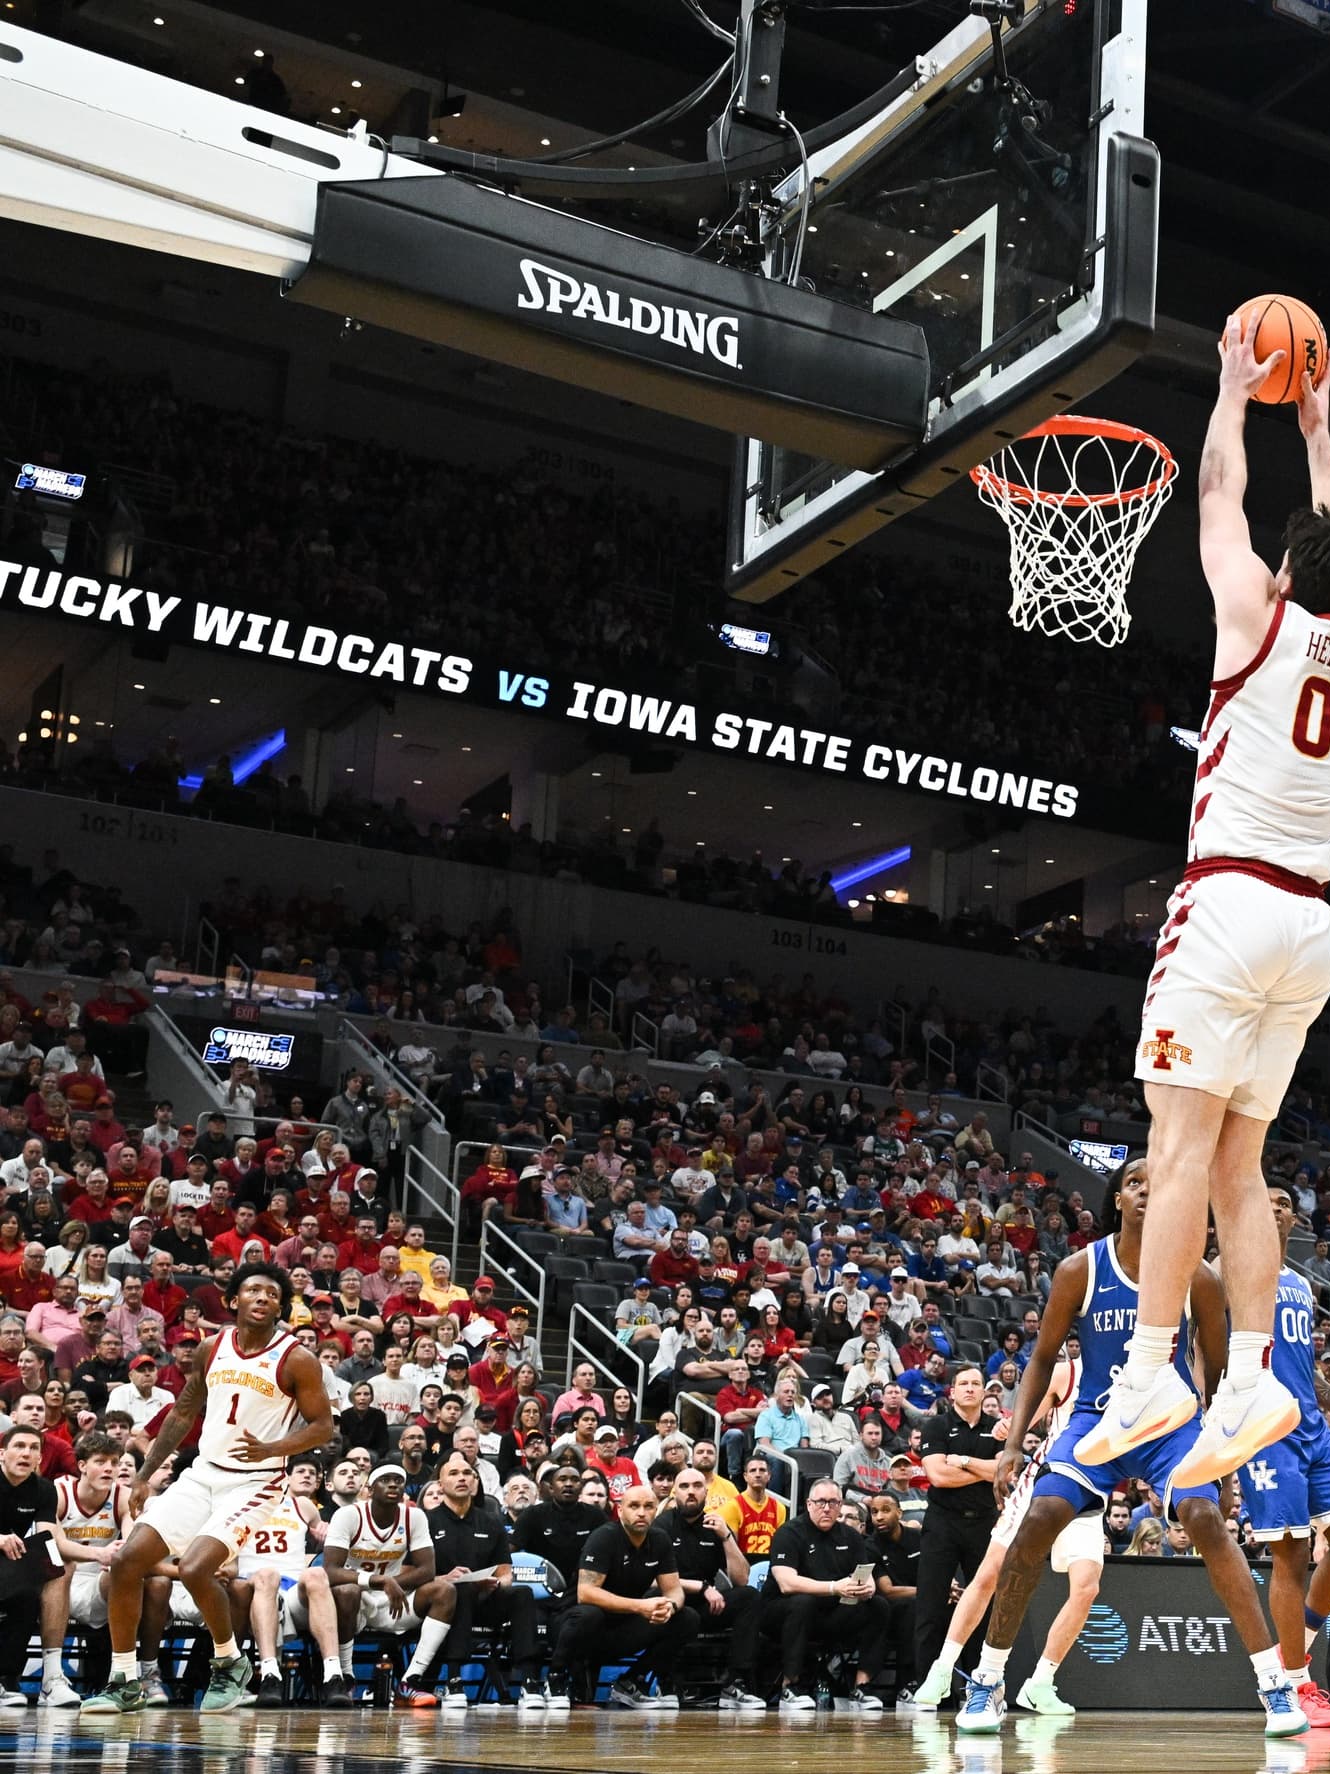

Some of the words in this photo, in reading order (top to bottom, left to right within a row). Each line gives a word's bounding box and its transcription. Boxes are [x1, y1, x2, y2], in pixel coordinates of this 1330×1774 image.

[518, 259, 739, 368] SPALDING
[194, 603, 472, 694] WILDCATS
[499, 671, 550, 708] VS
[567, 682, 697, 741] IOWA
[712, 713, 852, 772] STATE
[863, 745, 1079, 818] CYCLONES
[236, 1007, 256, 1018] EXIT
[225, 1032, 270, 1049] MARCH
[1142, 1040, 1193, 1064] STATE
[229, 1046, 288, 1065] MADNESS
[1281, 1307, 1310, 1345] 00
[208, 1369, 275, 1397] CYCLONES
[227, 1393, 240, 1425] 1
[1246, 1460, 1278, 1491] UK
[254, 1531, 288, 1554] 23
[747, 1535, 770, 1554] 22
[1139, 1616, 1232, 1654] AT&T
